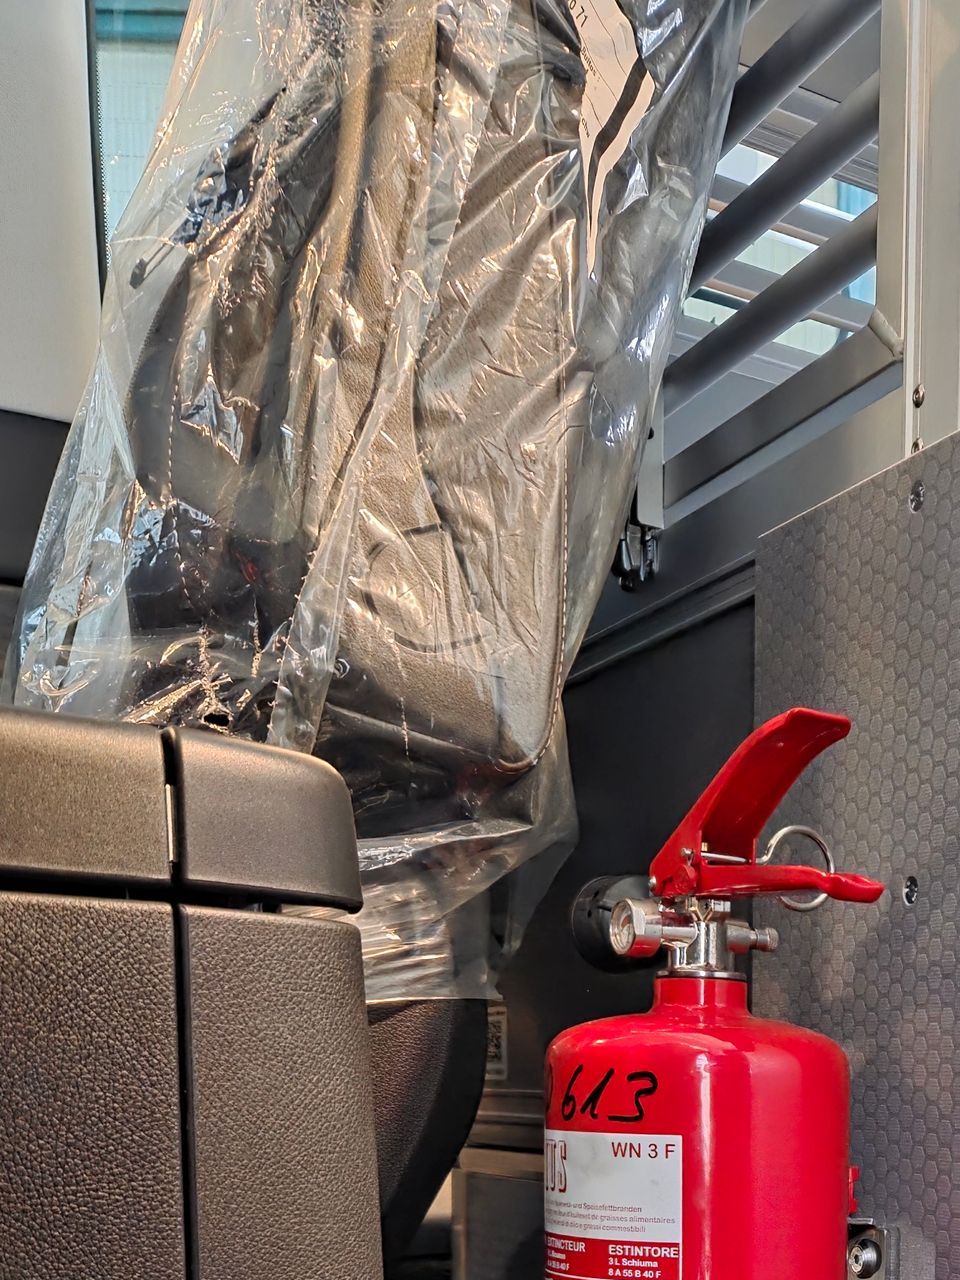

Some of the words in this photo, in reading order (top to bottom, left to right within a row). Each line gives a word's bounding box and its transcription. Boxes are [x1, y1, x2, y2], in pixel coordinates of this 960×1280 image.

[611, 1141, 641, 1158] WN
[648, 1143, 658, 1158] 3
[665, 1144, 675, 1158] F
[629, 1216, 676, 1224] alimentaires
[608, 1244, 679, 1258] ESTINTORE
[608, 1257, 614, 1265] 3
[621, 1258, 658, 1268] Schiuma
[608, 1268, 614, 1276] 8
[623, 1269, 633, 1277] 55
[643, 1270, 654, 1278] 40
